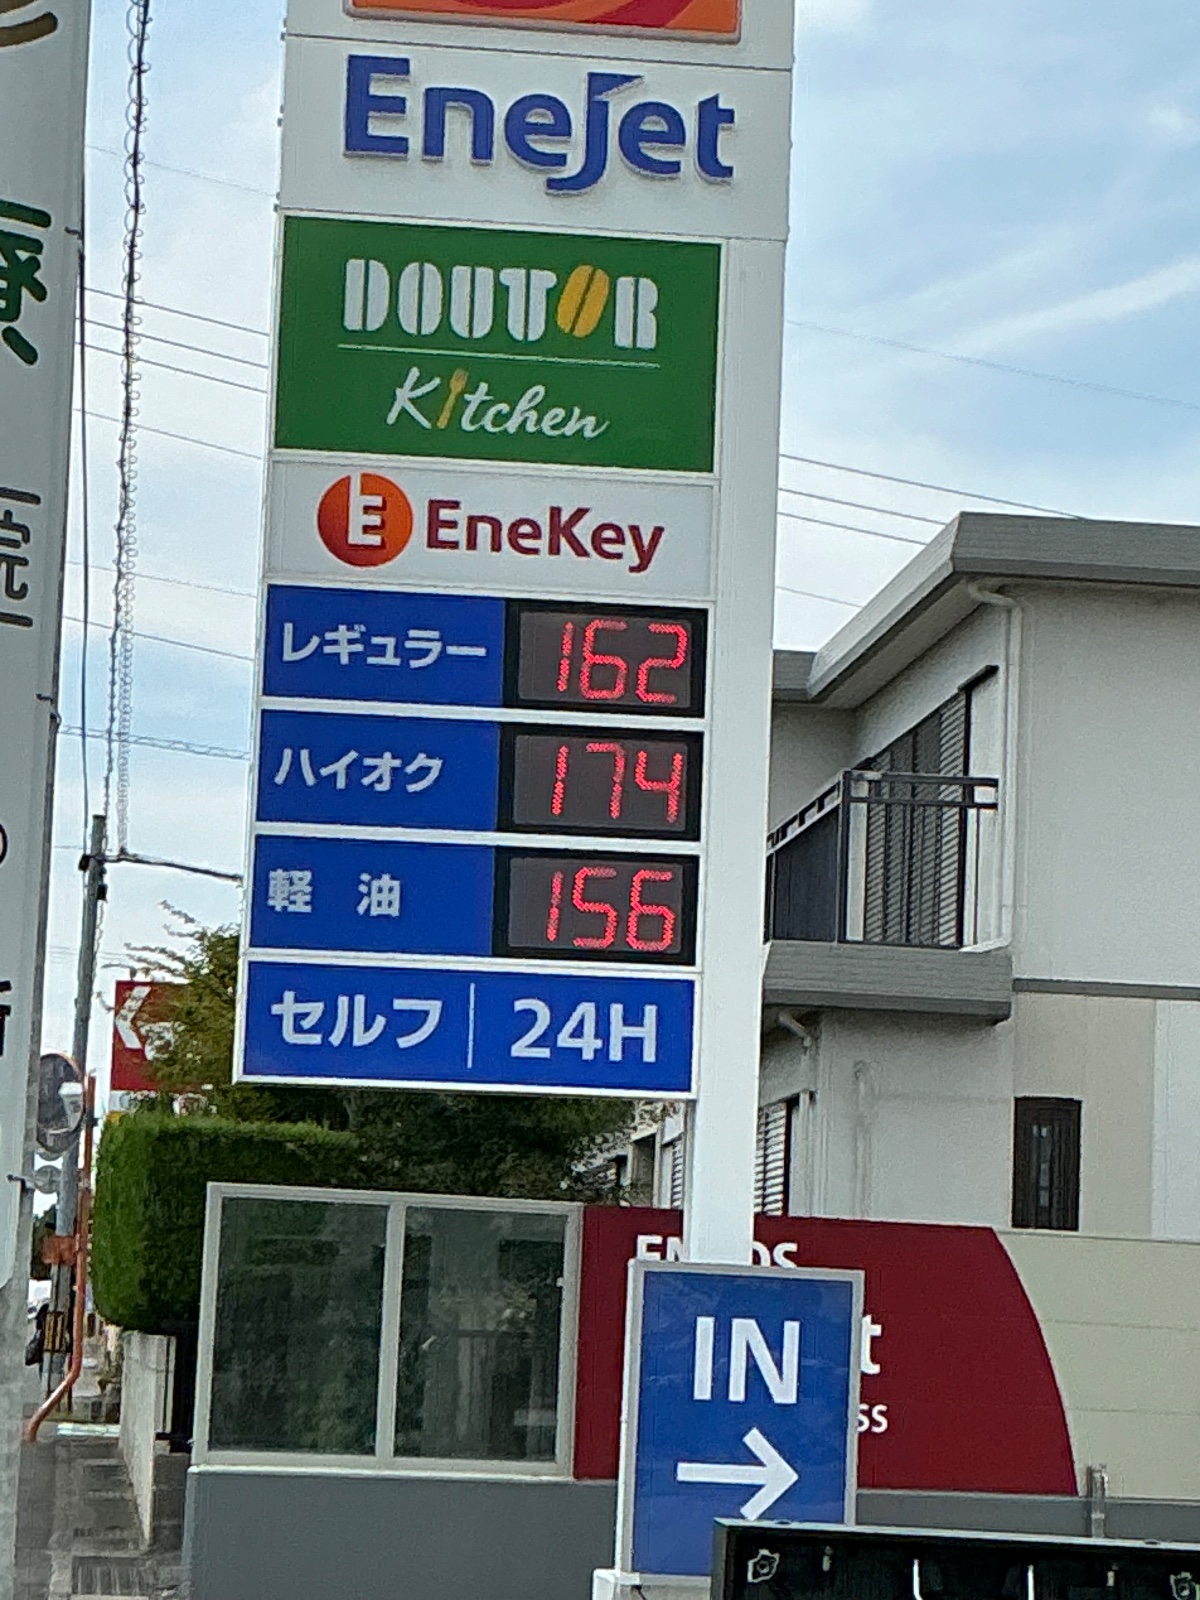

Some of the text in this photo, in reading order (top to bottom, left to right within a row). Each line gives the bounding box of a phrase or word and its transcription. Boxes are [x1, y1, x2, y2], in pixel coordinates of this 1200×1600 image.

[342, 258, 659, 350] DOUTOR
[385, 366, 610, 440] Kitchen
[426, 499, 665, 573] EneKey
[280, 621, 488, 669] レギュラー
[556, 618, 689, 703] 162
[274, 747, 444, 793] ハイオク
[551, 742, 683, 823] 174
[545, 865, 676, 951] 156
[270, 990, 659, 1063] セルフ 24H
[692, 1315, 801, 1405] IN
